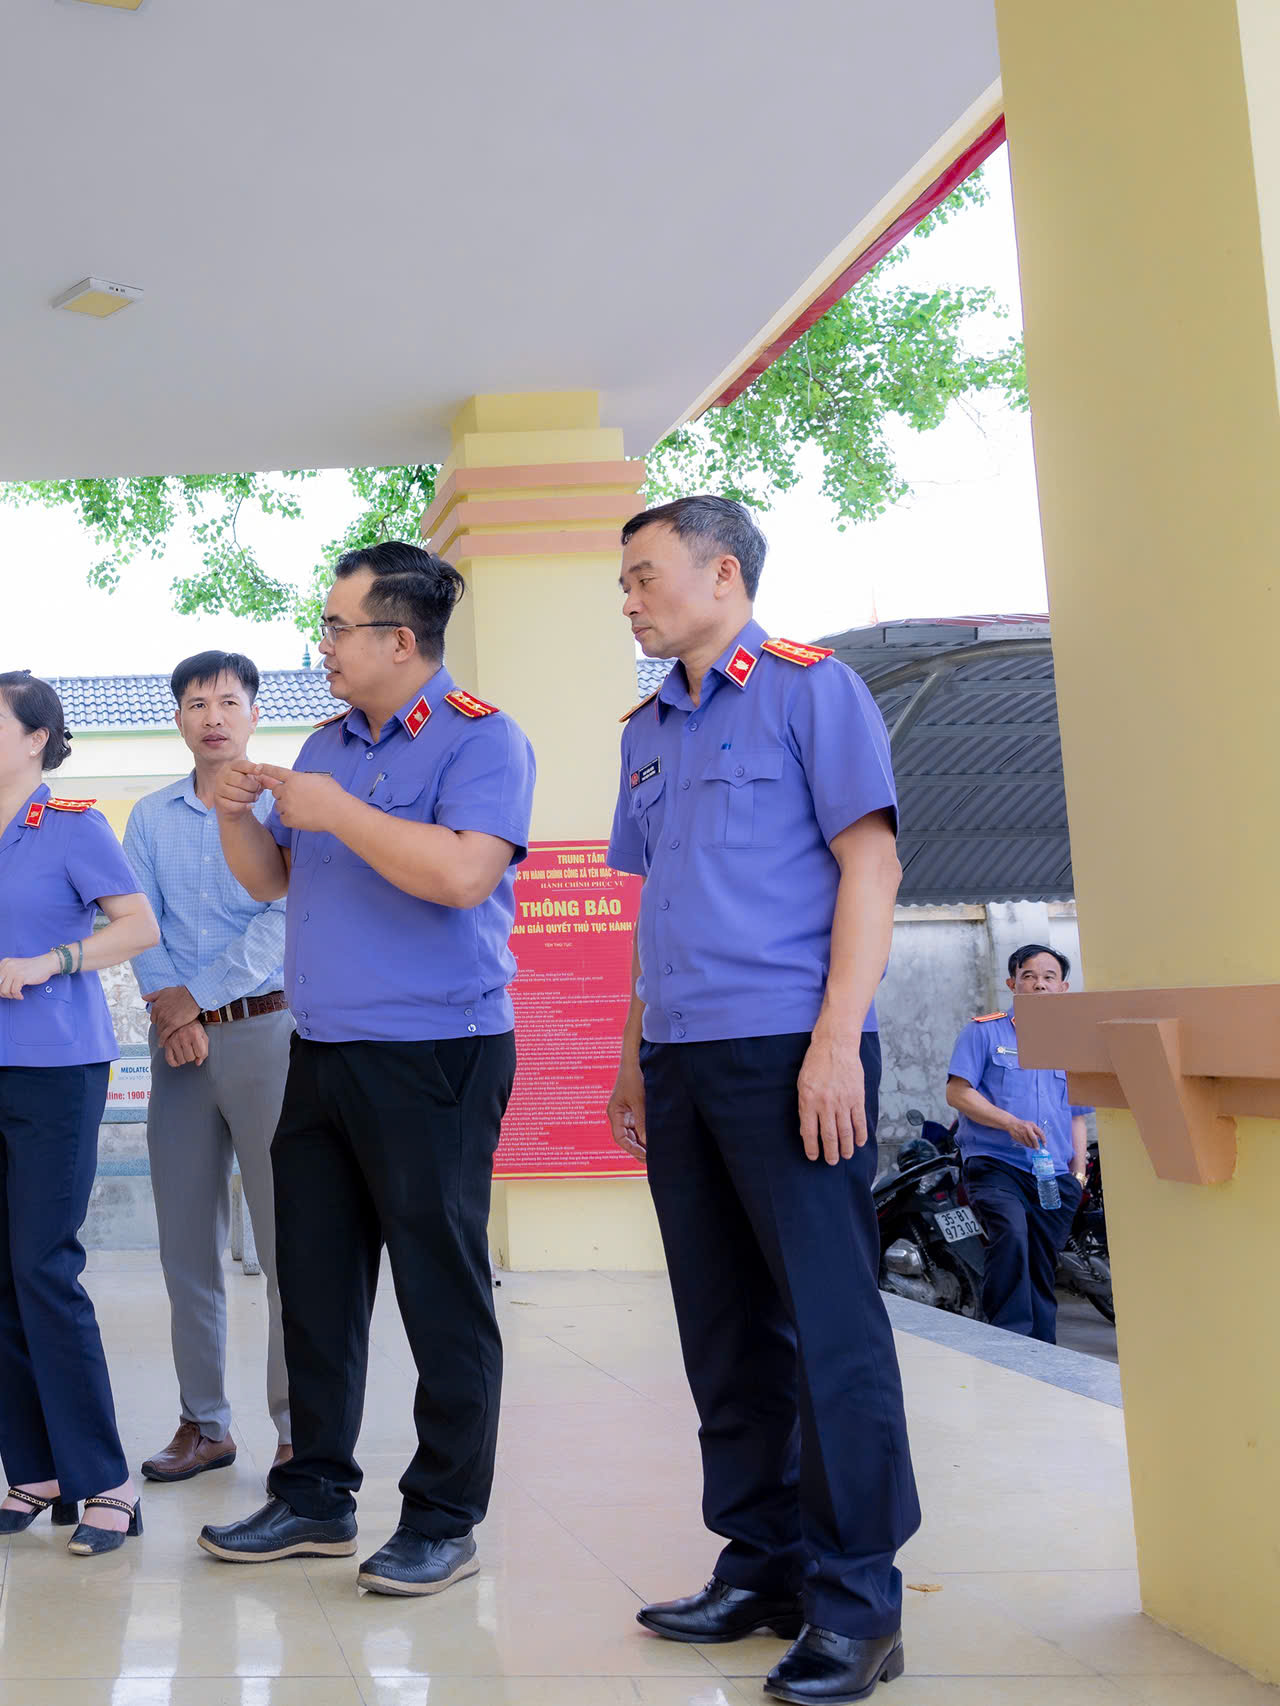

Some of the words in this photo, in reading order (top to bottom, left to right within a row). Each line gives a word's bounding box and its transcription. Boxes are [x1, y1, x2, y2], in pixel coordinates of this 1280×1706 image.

[557, 854, 585, 864] TRUNG
[587, 852, 605, 863] TÂM
[519, 898, 579, 918] THÔNG
[584, 896, 621, 916] BÁO
[511, 925, 525, 934] IAN
[527, 922, 544, 934] GIẢI
[546, 921, 571, 934] QUYẾT
[573, 920, 589, 933] THỦ
[591, 922, 607, 933] TỤC
[609, 920, 632, 931] HÀNH
[107, 1091, 125, 1100] line:
[127, 1090, 145, 1100] 1900
[942, 1209, 969, 1226] 35-B1
[945, 1221, 980, 1239] 973.02
